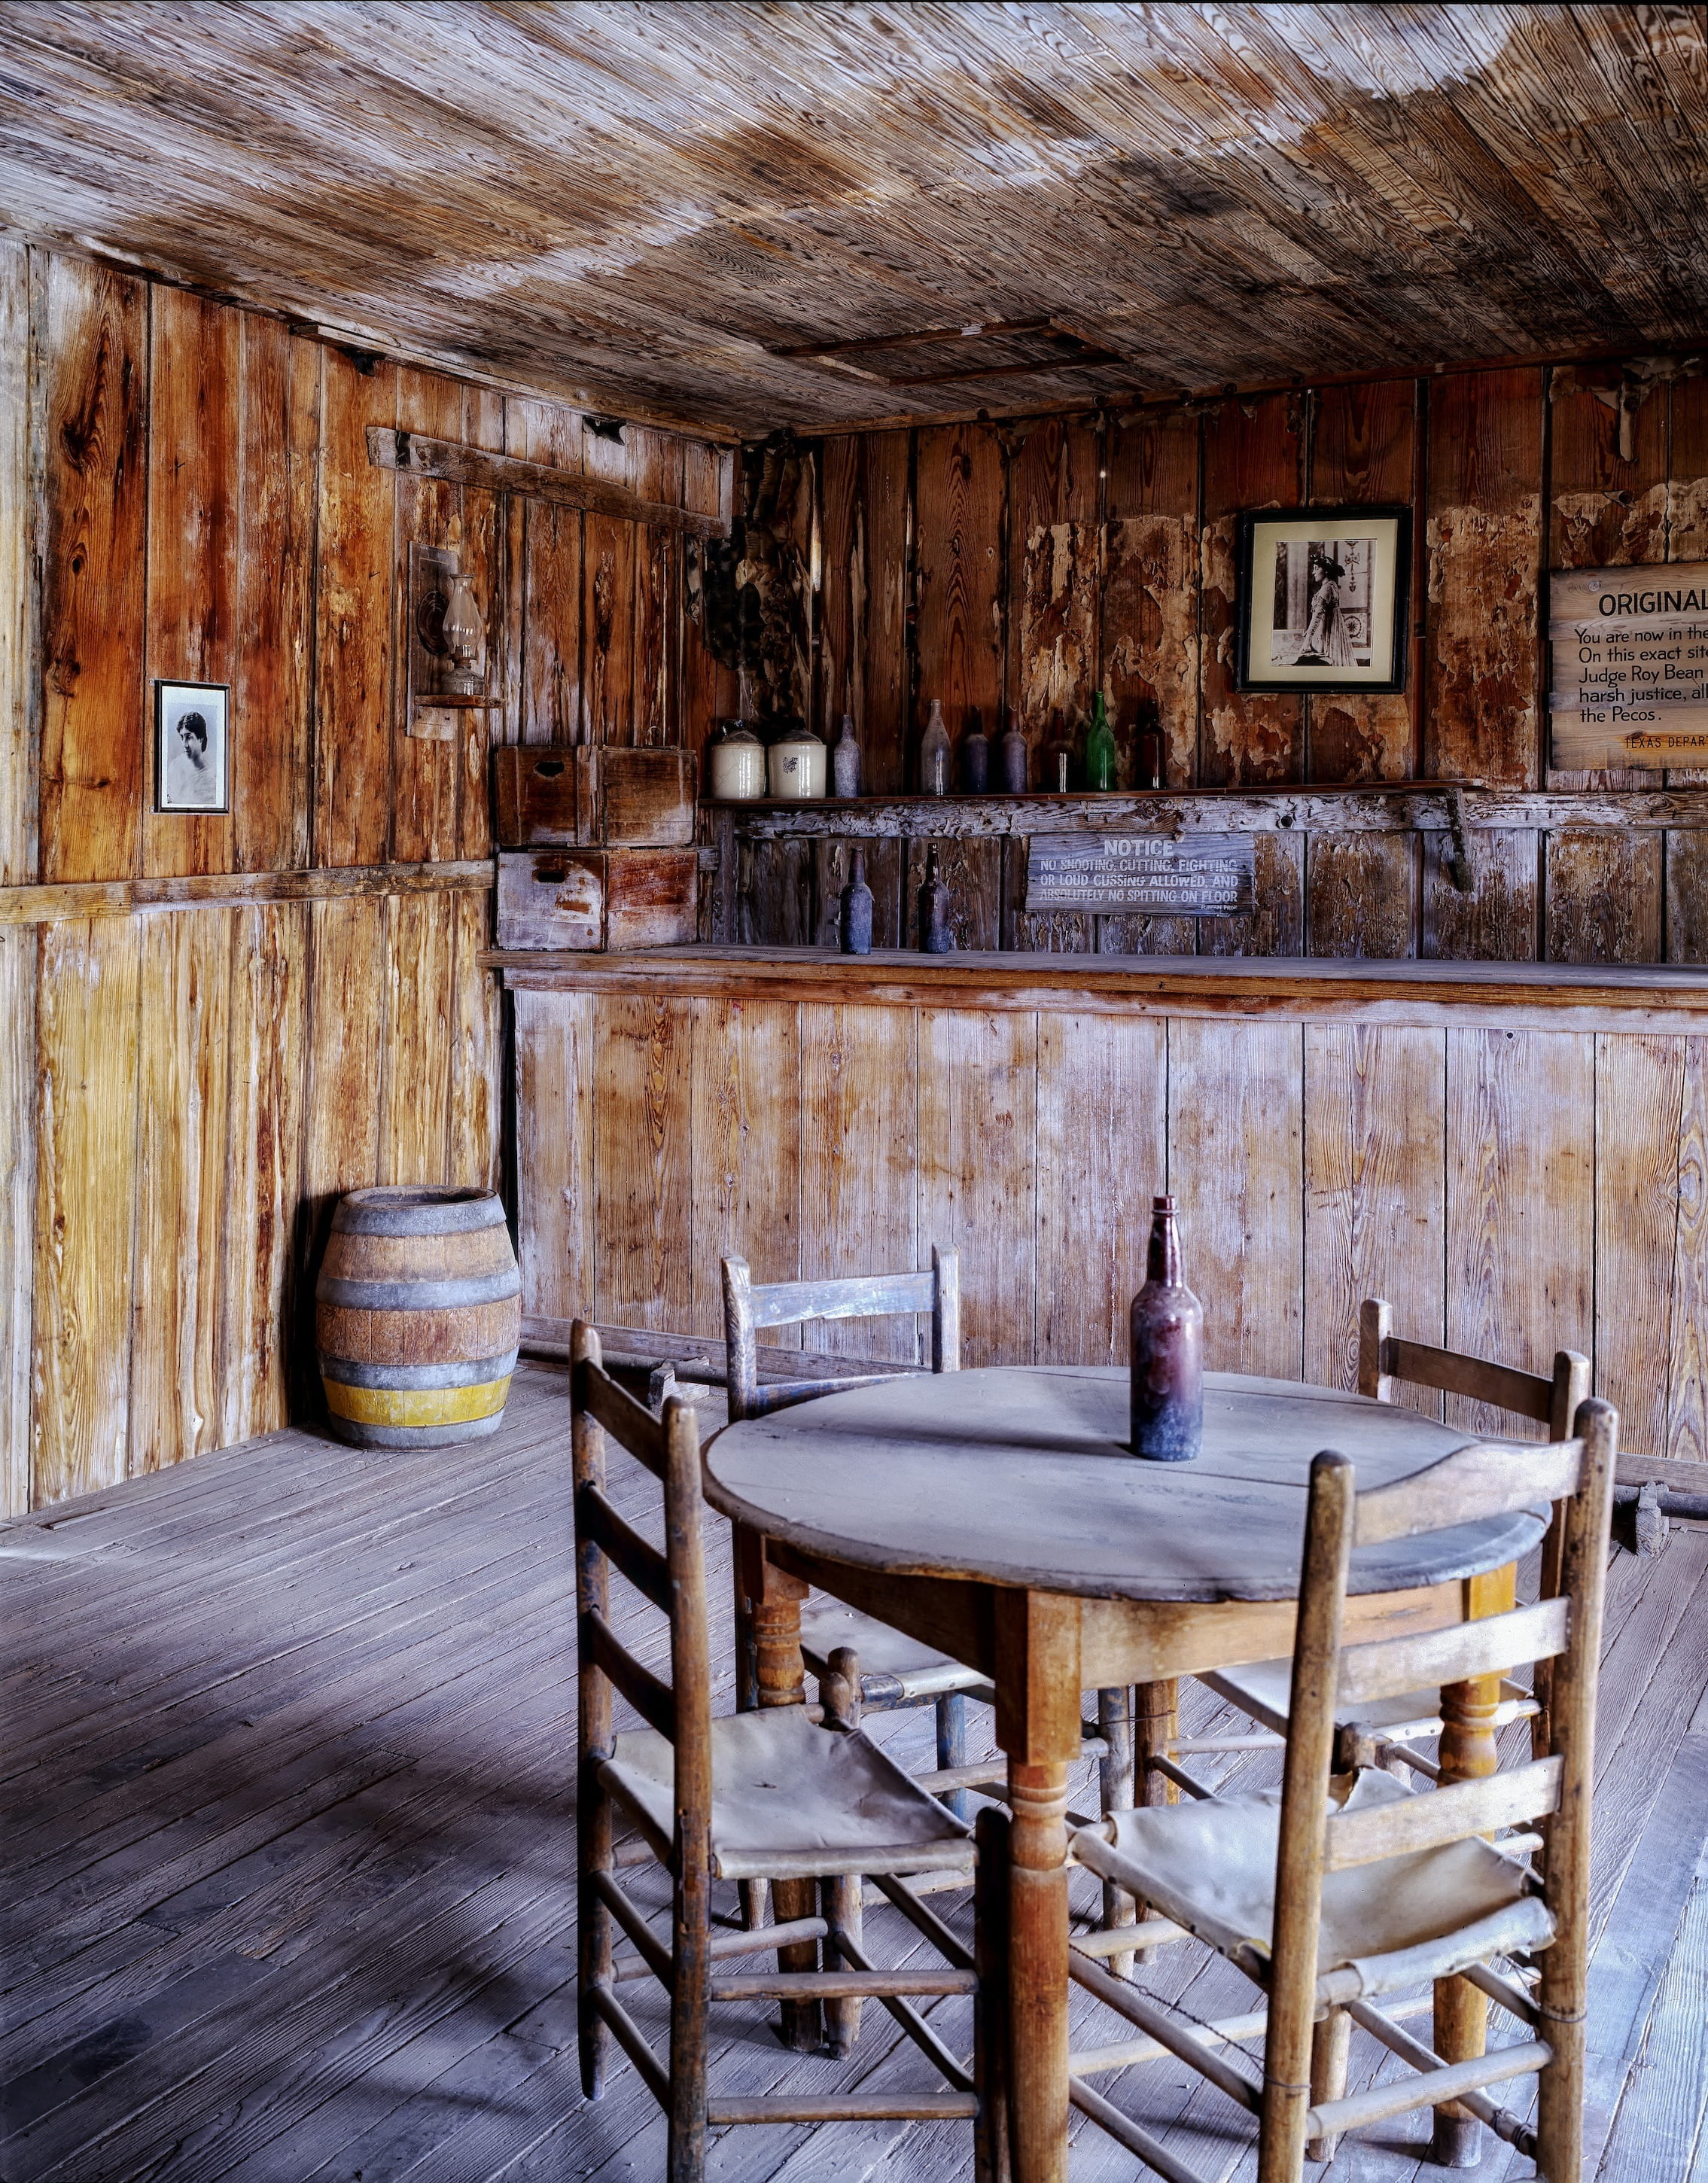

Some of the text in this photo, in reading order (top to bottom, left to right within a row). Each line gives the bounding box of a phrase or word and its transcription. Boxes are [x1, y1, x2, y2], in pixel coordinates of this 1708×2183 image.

[1599, 589, 1708, 616] ORIGINAL
[1574, 624, 1708, 644] You are now in the
[1579, 647, 1601, 663] On
[1607, 646, 1635, 662] this
[1639, 646, 1682, 660] exact
[1579, 664, 1703, 687] Judge Roy Bean
[1579, 684, 1708, 705] harsh justice, all
[1580, 706, 1661, 723] the Pecos.
[1624, 735, 1708, 748] TEXAS DEPAR
[1104, 839, 1174, 857] NOTICE
[1040, 859, 1238, 873] NO SHOOTING, CUTTING, FIGHTING
[1040, 874, 1239, 888] OR LOUD CUSSING ALLOWED, AND
[1039, 888, 1238, 903] ABSOLUTELY NO SPITTING ON FLOOR
